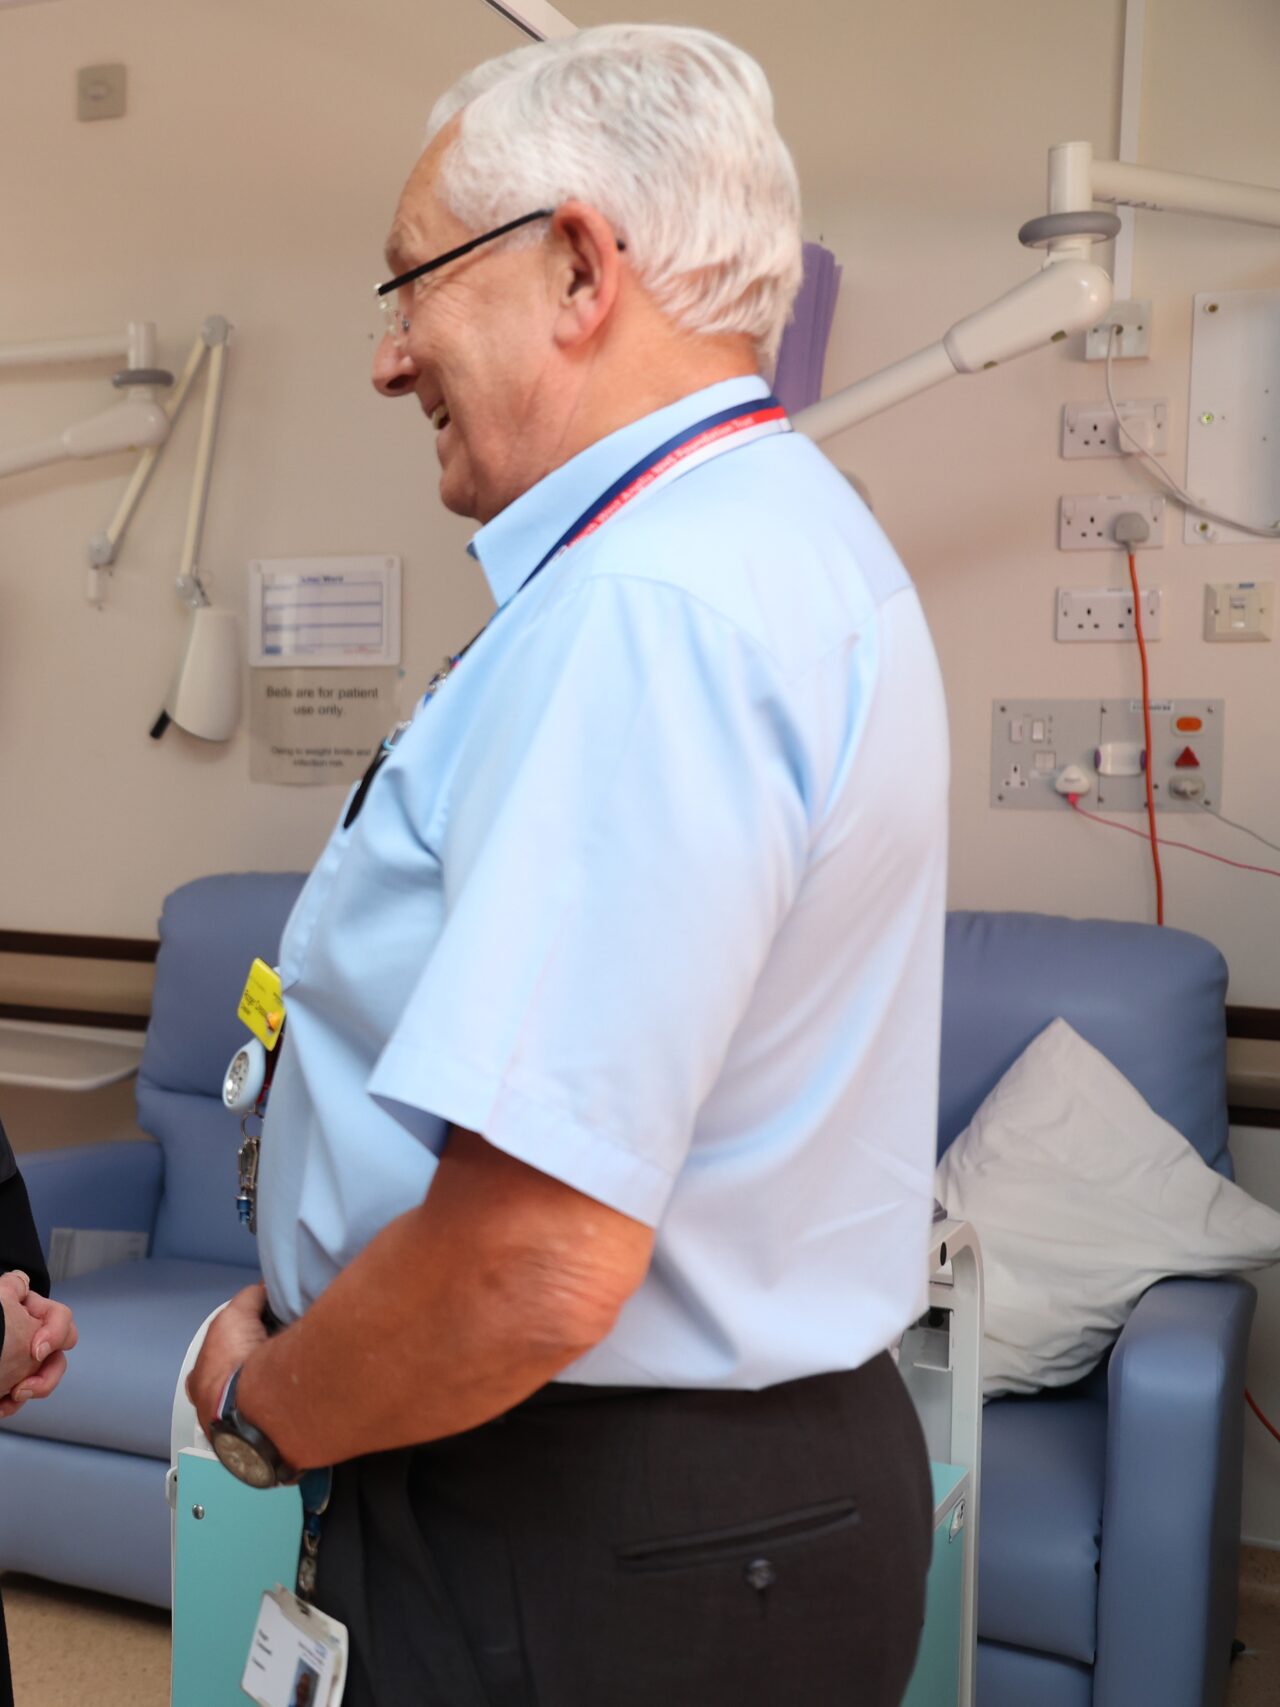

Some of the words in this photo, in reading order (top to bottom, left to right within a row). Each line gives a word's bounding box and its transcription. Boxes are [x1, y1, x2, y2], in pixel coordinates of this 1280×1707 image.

[621, 473, 656, 502] Anglia
[675, 423, 734, 461] Foundation
[266, 686, 292, 698] Beds
[296, 688, 315, 698] are
[318, 686, 334, 698] for
[338, 687, 378, 700] patient
[294, 706, 314, 715] use
